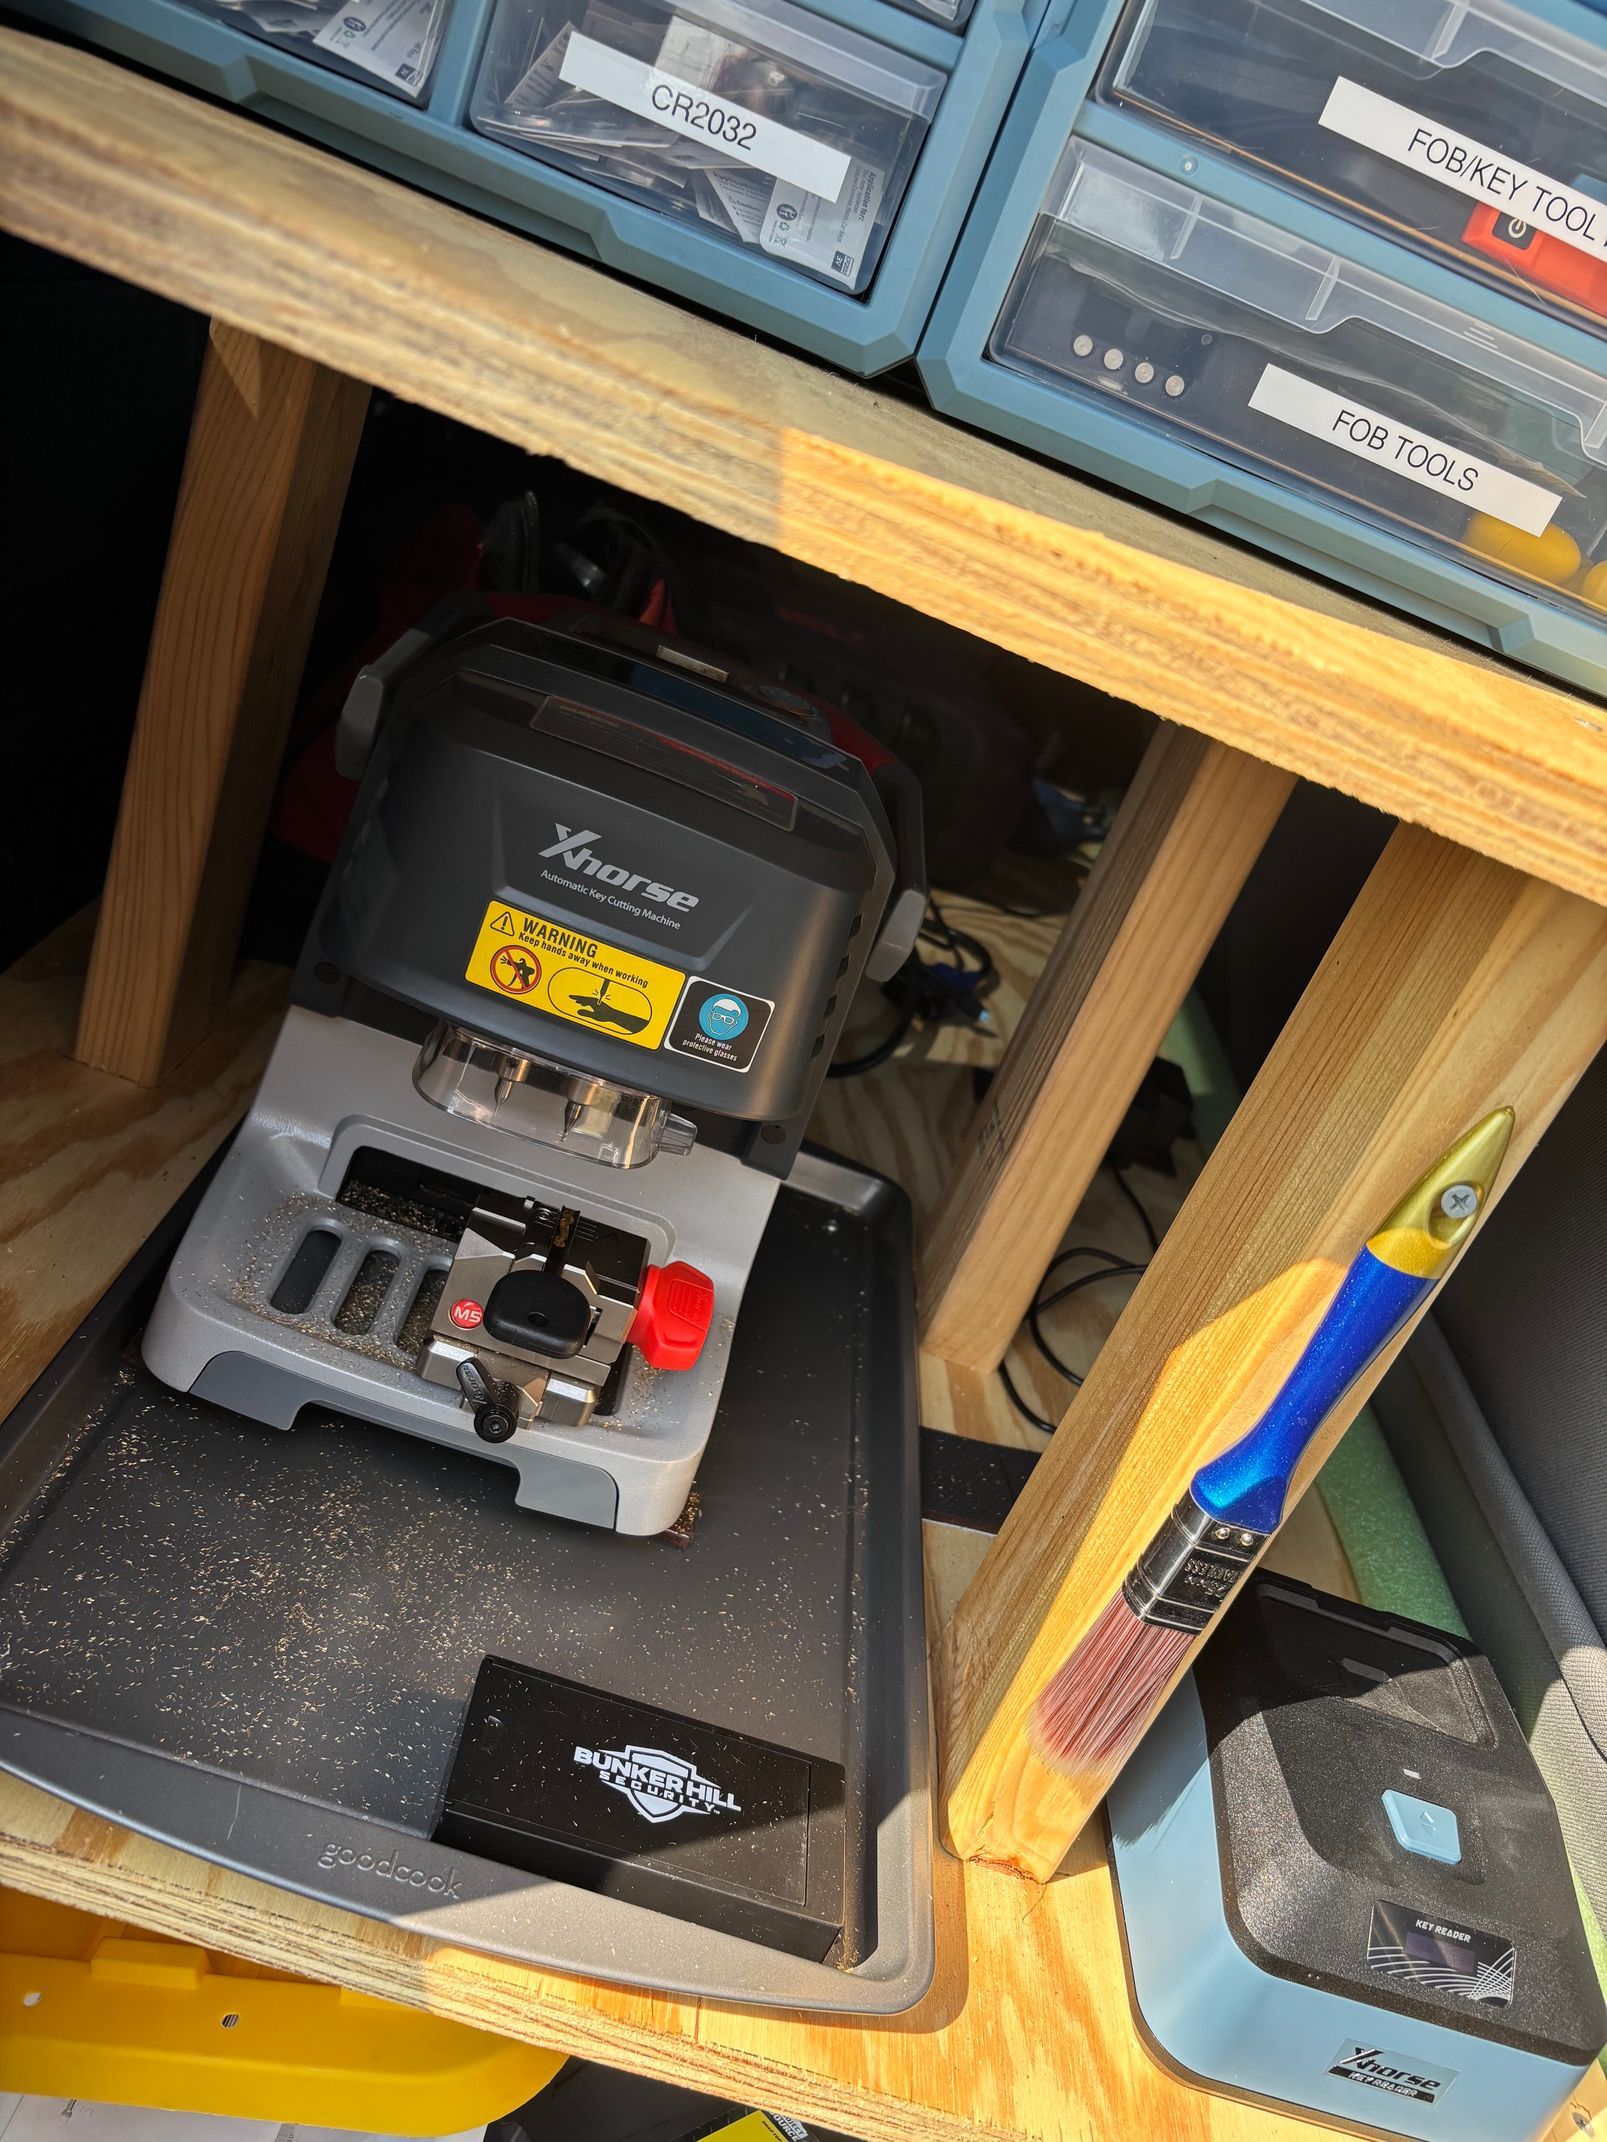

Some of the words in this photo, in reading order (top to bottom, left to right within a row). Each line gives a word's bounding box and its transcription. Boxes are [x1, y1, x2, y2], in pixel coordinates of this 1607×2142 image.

[652, 84, 757, 151] CR2032
[1407, 128, 1529, 201] FOB/KEY
[1531, 185, 1597, 241] TOOL
[1332, 409, 1389, 450] FOB
[1394, 435, 1479, 491] TOOLS
[538, 822, 700, 912] Xhorse
[540, 869, 588, 896] Automatic
[588, 888, 608, 905] Key
[607, 896, 642, 917] Cutting
[641, 908, 681, 930] Machine
[518, 931, 539, 947] Keep
[540, 941, 567, 958] hands
[567, 951, 592, 968] away
[591, 960, 614, 976] when
[615, 970, 650, 988] working
[522, 917, 599, 959] WARNING
[682, 1039, 713, 1054] protective
[713, 1049, 738, 1062] glasses
[694, 1032, 715, 1046] Please
[716, 1041, 732, 1051] wear
[453, 1305, 483, 1324] M5
[573, 1745, 685, 1794] BUNKER
[685, 1780, 742, 1812] HILL
[317, 1842, 464, 1900] goodcook
[1415, 1918, 1434, 1932] KEY
[1433, 1925, 1472, 1944] READER
[1339, 2047, 1441, 2091] Xhorse
[1347, 2071, 1373, 2083] KEY
[782, 2115, 805, 2136] OJECT
